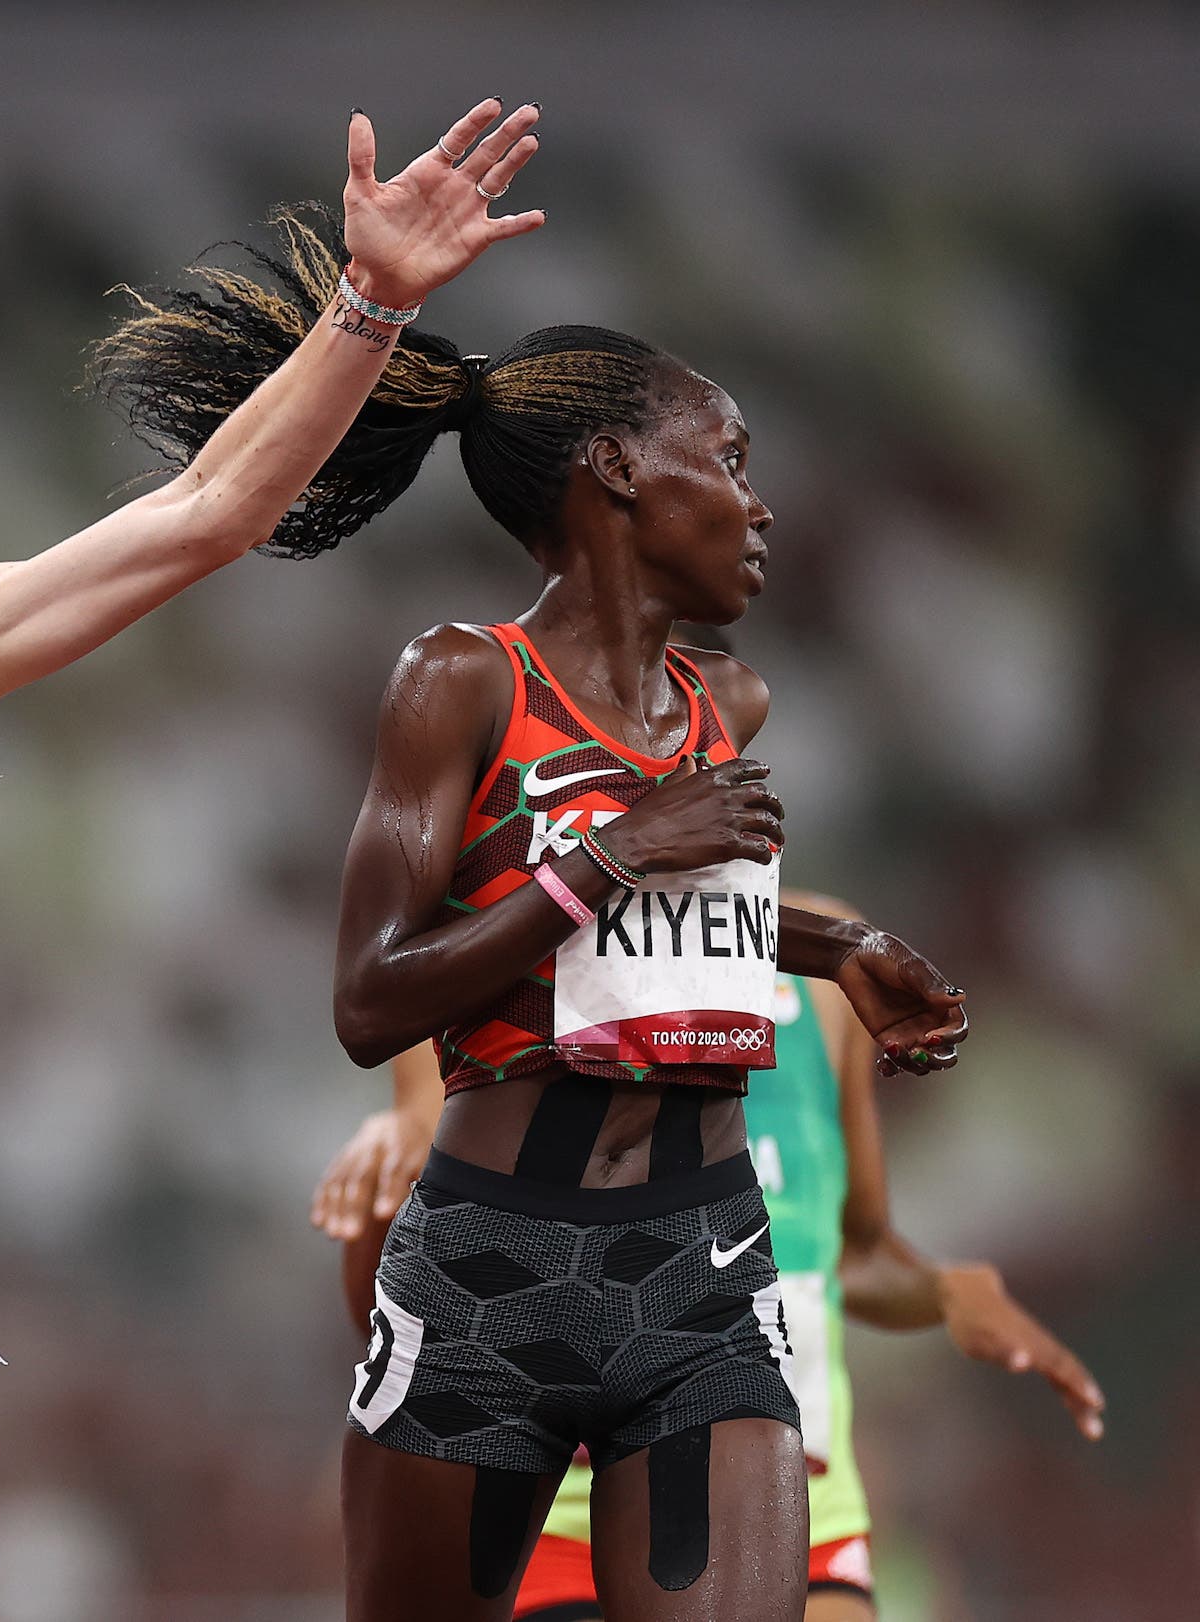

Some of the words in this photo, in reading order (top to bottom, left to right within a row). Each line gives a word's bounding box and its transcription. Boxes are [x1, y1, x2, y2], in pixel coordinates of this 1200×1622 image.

[332, 294, 391, 352] Belong
[596, 891, 776, 963] KIYENG
[651, 1030, 696, 1045] TOKYO
[697, 1031, 726, 1046] 2020
